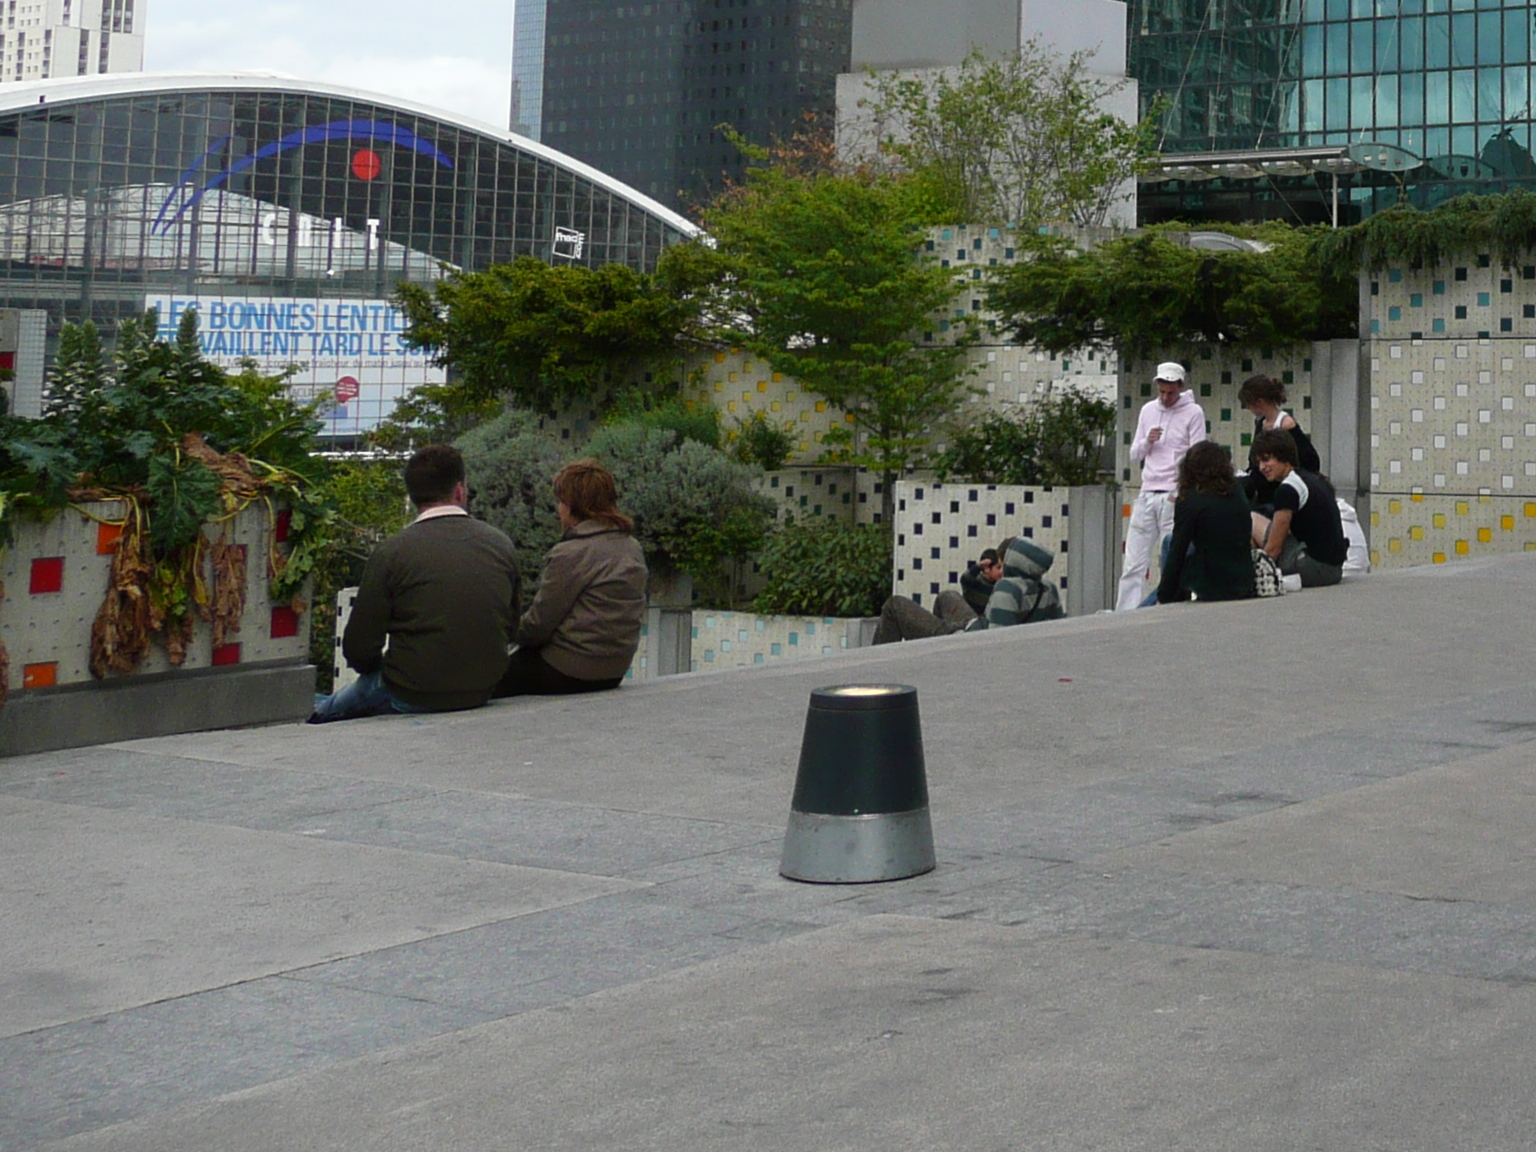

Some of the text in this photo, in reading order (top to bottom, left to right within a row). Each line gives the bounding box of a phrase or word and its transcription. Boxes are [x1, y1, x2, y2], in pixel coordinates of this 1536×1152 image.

[210, 301, 316, 331] BONNES
[309, 332, 361, 356] TARD
[368, 333, 391, 356] LE
